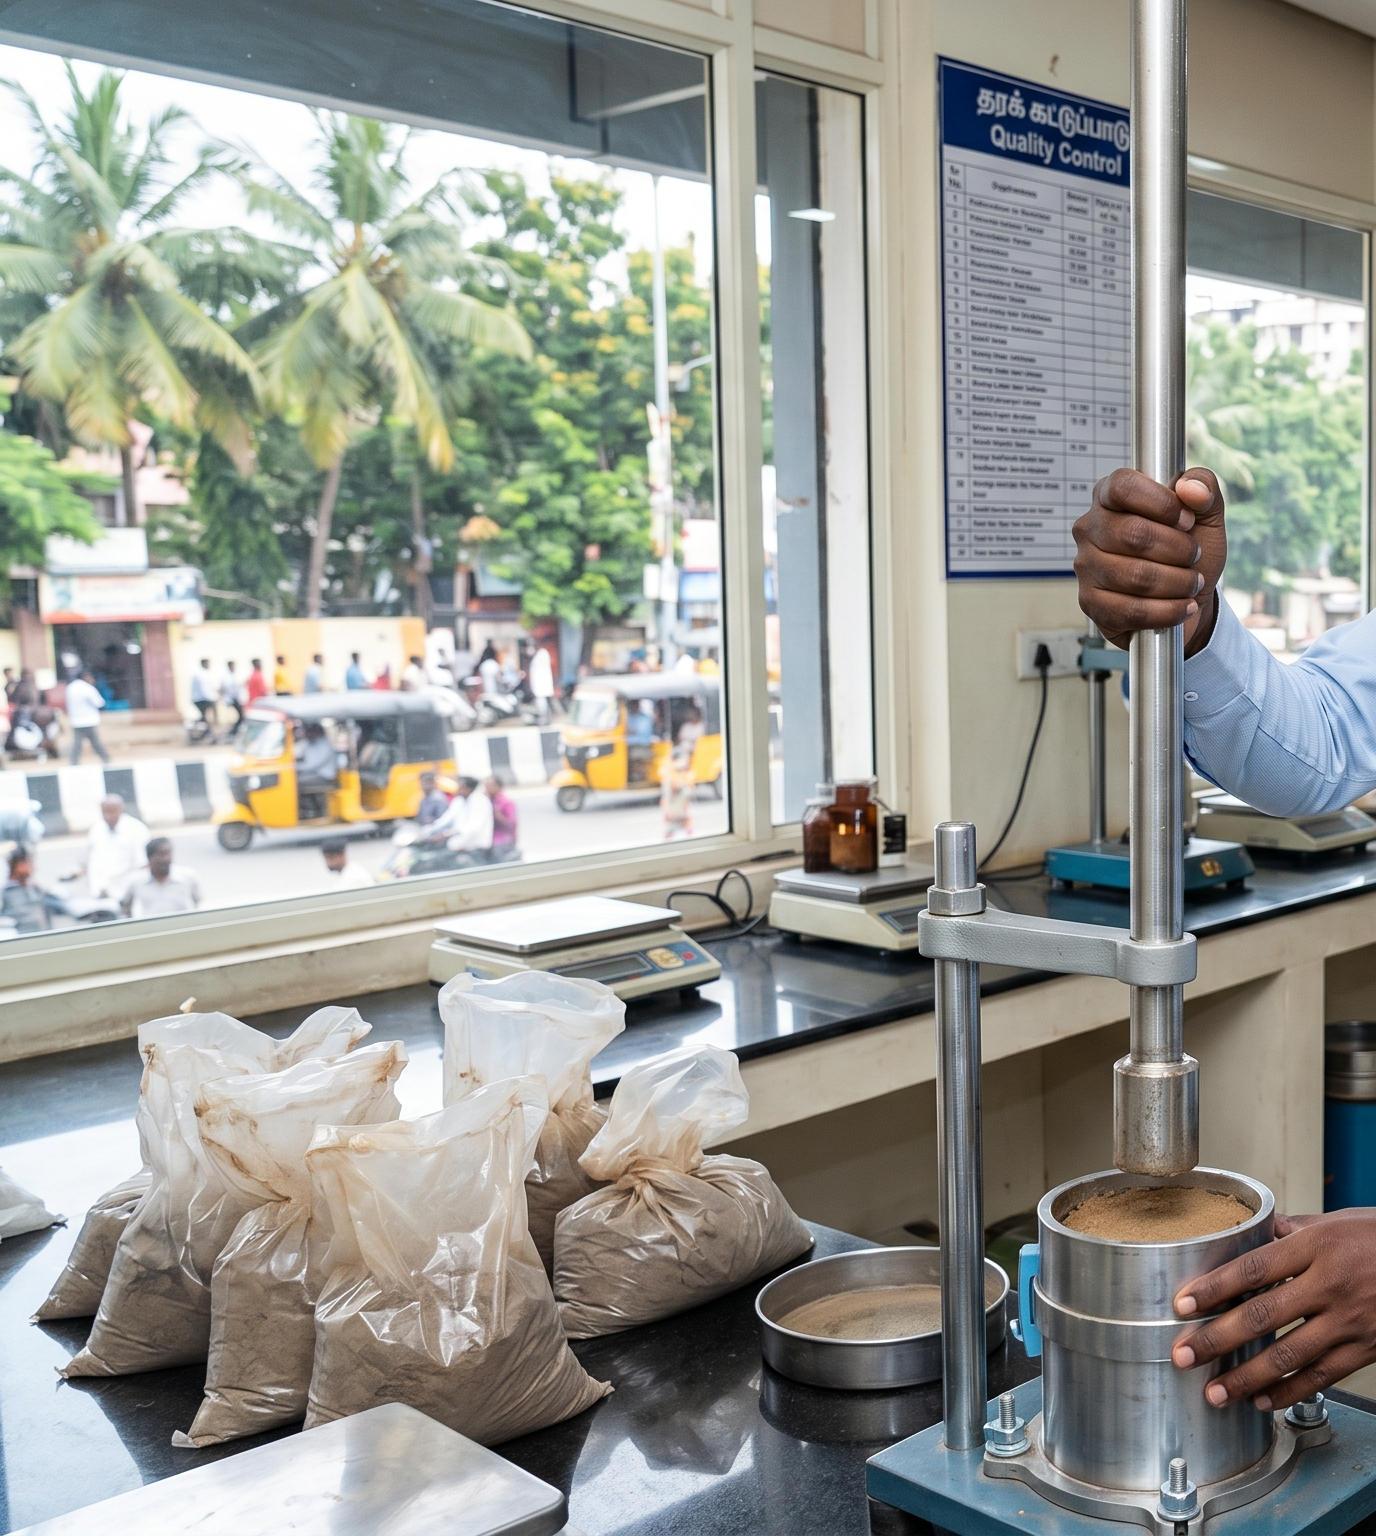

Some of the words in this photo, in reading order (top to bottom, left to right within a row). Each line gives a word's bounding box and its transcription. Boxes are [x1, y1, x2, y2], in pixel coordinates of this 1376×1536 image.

[976, 88, 1026, 119] தரக்
[1028, 102, 1130, 152] கட்டுப்பாடு
[990, 124, 1055, 165] Quality
[1058, 141, 1122, 176] Control
